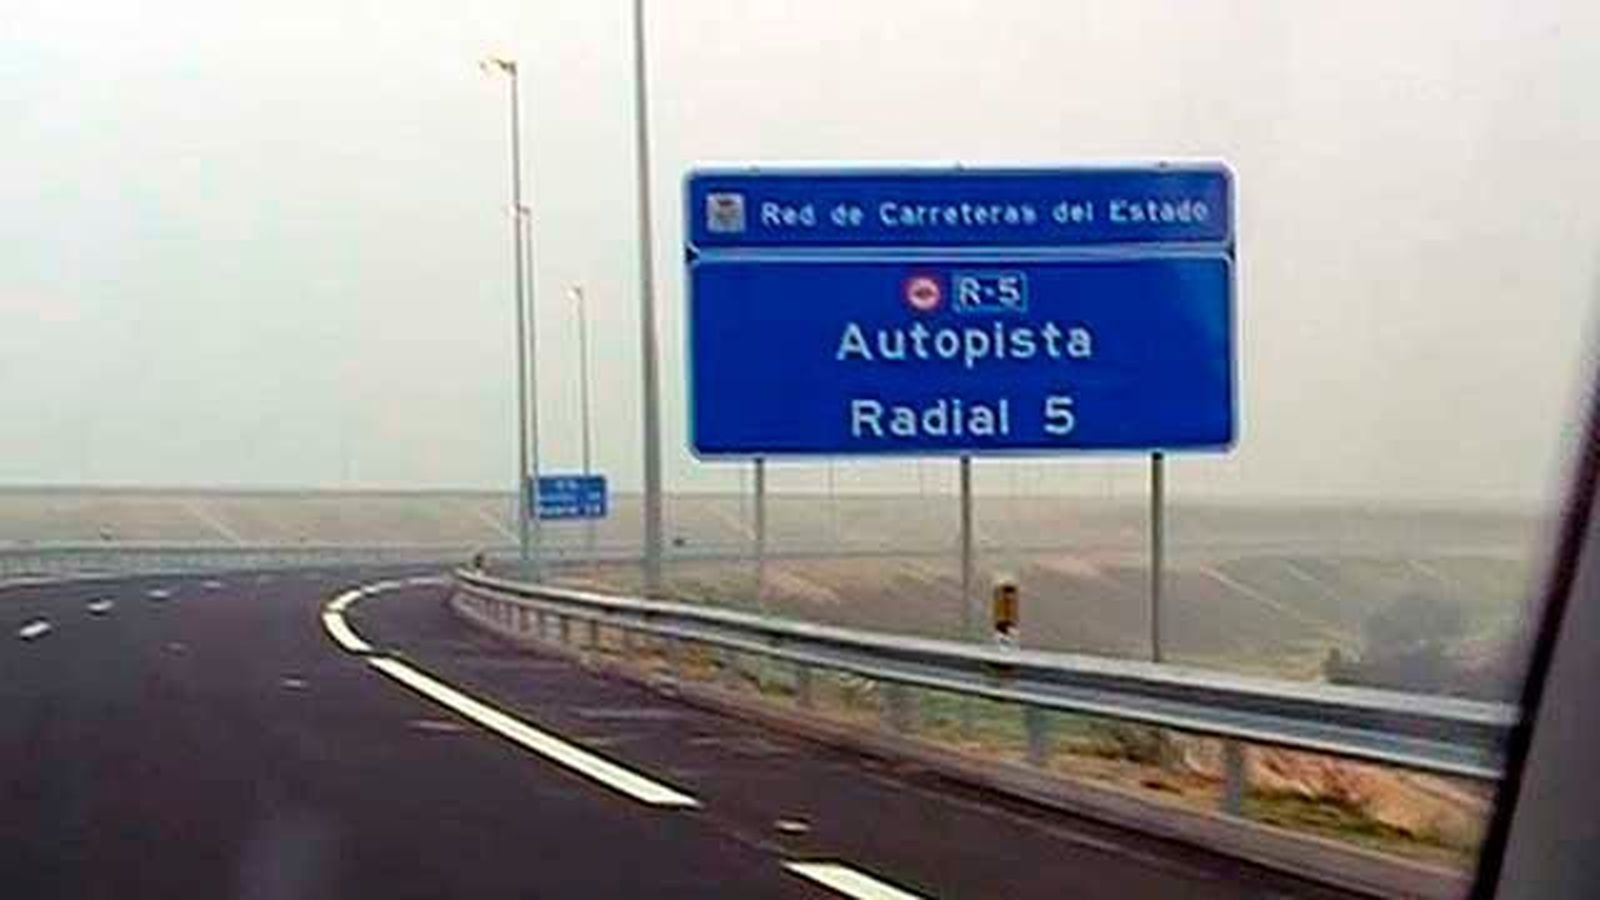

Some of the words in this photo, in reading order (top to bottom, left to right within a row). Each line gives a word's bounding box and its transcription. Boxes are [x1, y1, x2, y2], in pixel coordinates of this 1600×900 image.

[761, 202, 815, 227] Red
[831, 202, 863, 226] de
[879, 201, 1037, 226] Carreteras
[1053, 200, 1094, 224] del
[1109, 197, 1209, 223] Estado
[958, 276, 1020, 305] R-5
[836, 322, 1093, 367] Autopista
[850, 397, 1009, 437] Radial
[1044, 396, 1075, 436] 5
